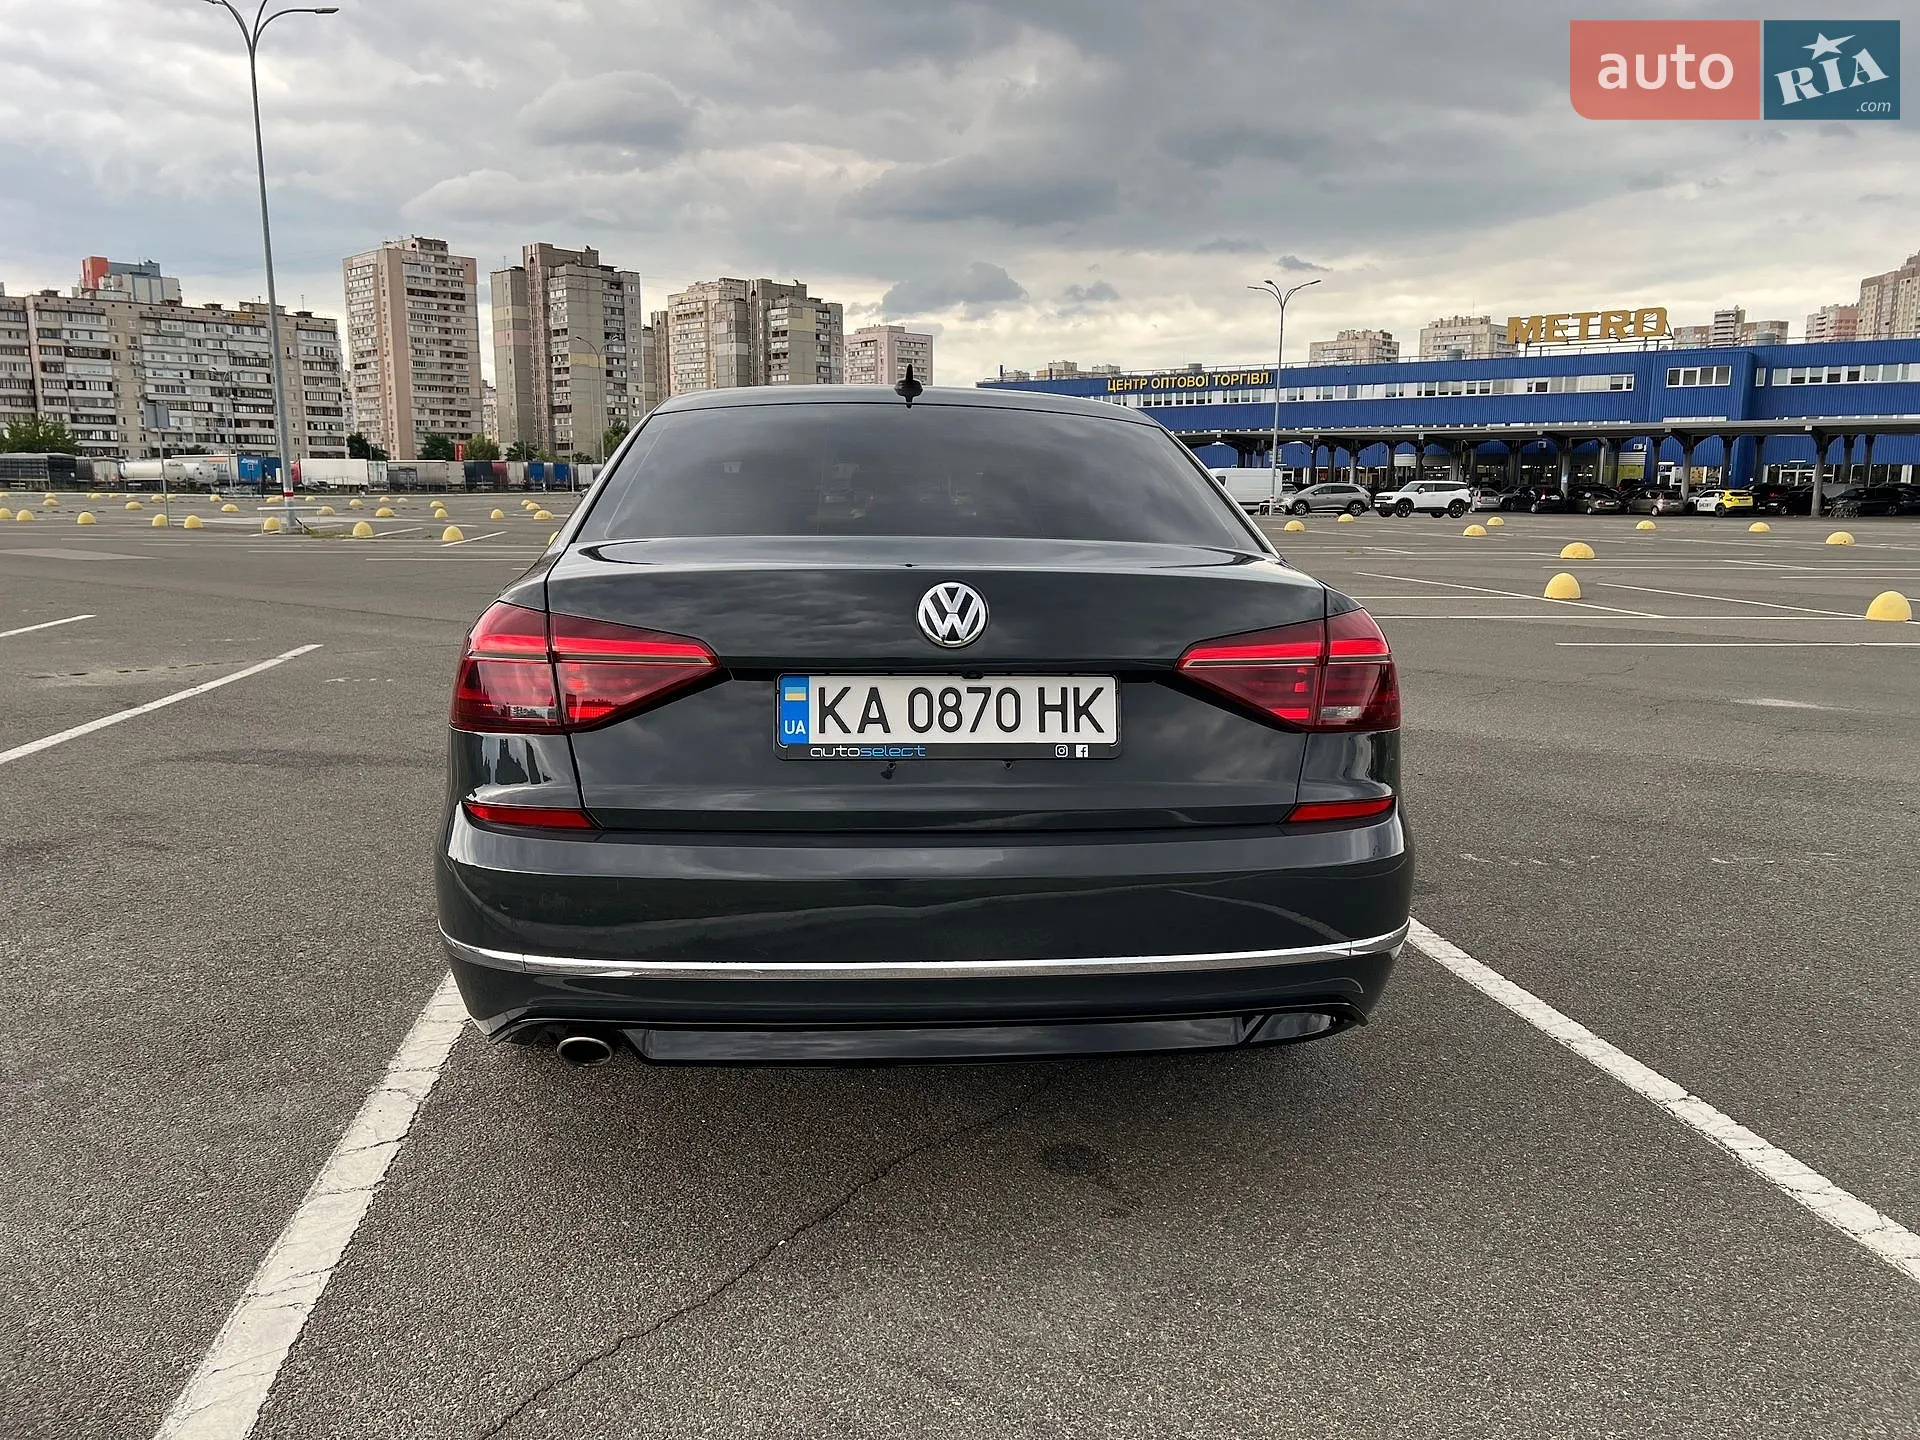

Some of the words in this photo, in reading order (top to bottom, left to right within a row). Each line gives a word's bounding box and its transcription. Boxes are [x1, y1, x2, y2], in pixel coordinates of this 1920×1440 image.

[1507, 307, 1667, 344] METRO
[1107, 378, 1148, 392] ЦЕНТР
[1151, 373, 1210, 389] ОПТОВОЇ
[818, 686, 892, 734] KA
[907, 686, 1021, 734] 0870
[1037, 686, 1105, 734] HK
[784, 719, 806, 735] UA
[810, 744, 926, 758] autoselect
